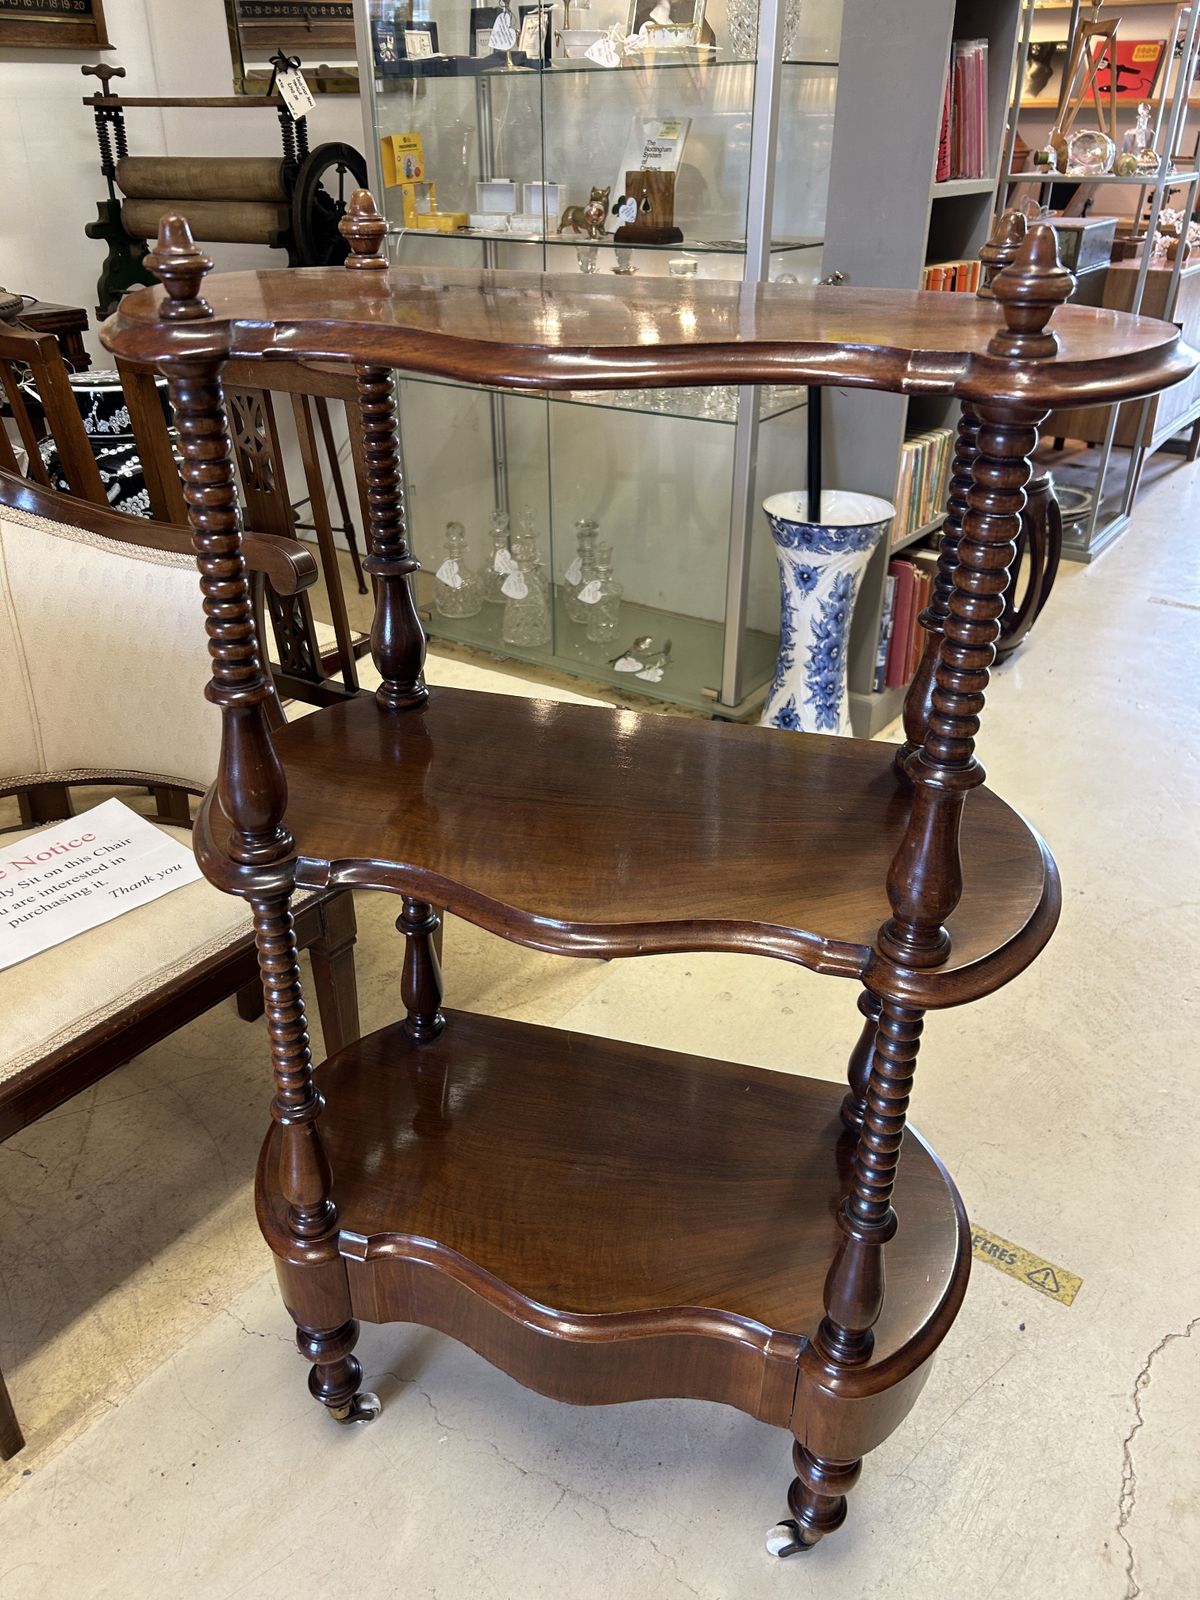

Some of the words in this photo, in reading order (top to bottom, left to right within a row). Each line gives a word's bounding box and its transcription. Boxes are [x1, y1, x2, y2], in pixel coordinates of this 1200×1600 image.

[61, 0, 71, 9] 19
[73, 1, 85, 10] 20
[7, 833, 97, 872] Notice
[17, 876, 42, 889] Sit
[43, 867, 63, 879] on
[64, 855, 92, 869] this
[93, 838, 132, 856] Chair
[11, 896, 36, 910] are
[37, 863, 109, 897] interested
[109, 857, 127, 866] in
[108, 875, 155, 899] Thank
[156, 863, 182, 880] you
[8, 887, 93, 929] purchasing
[91, 880, 109, 889] it.
